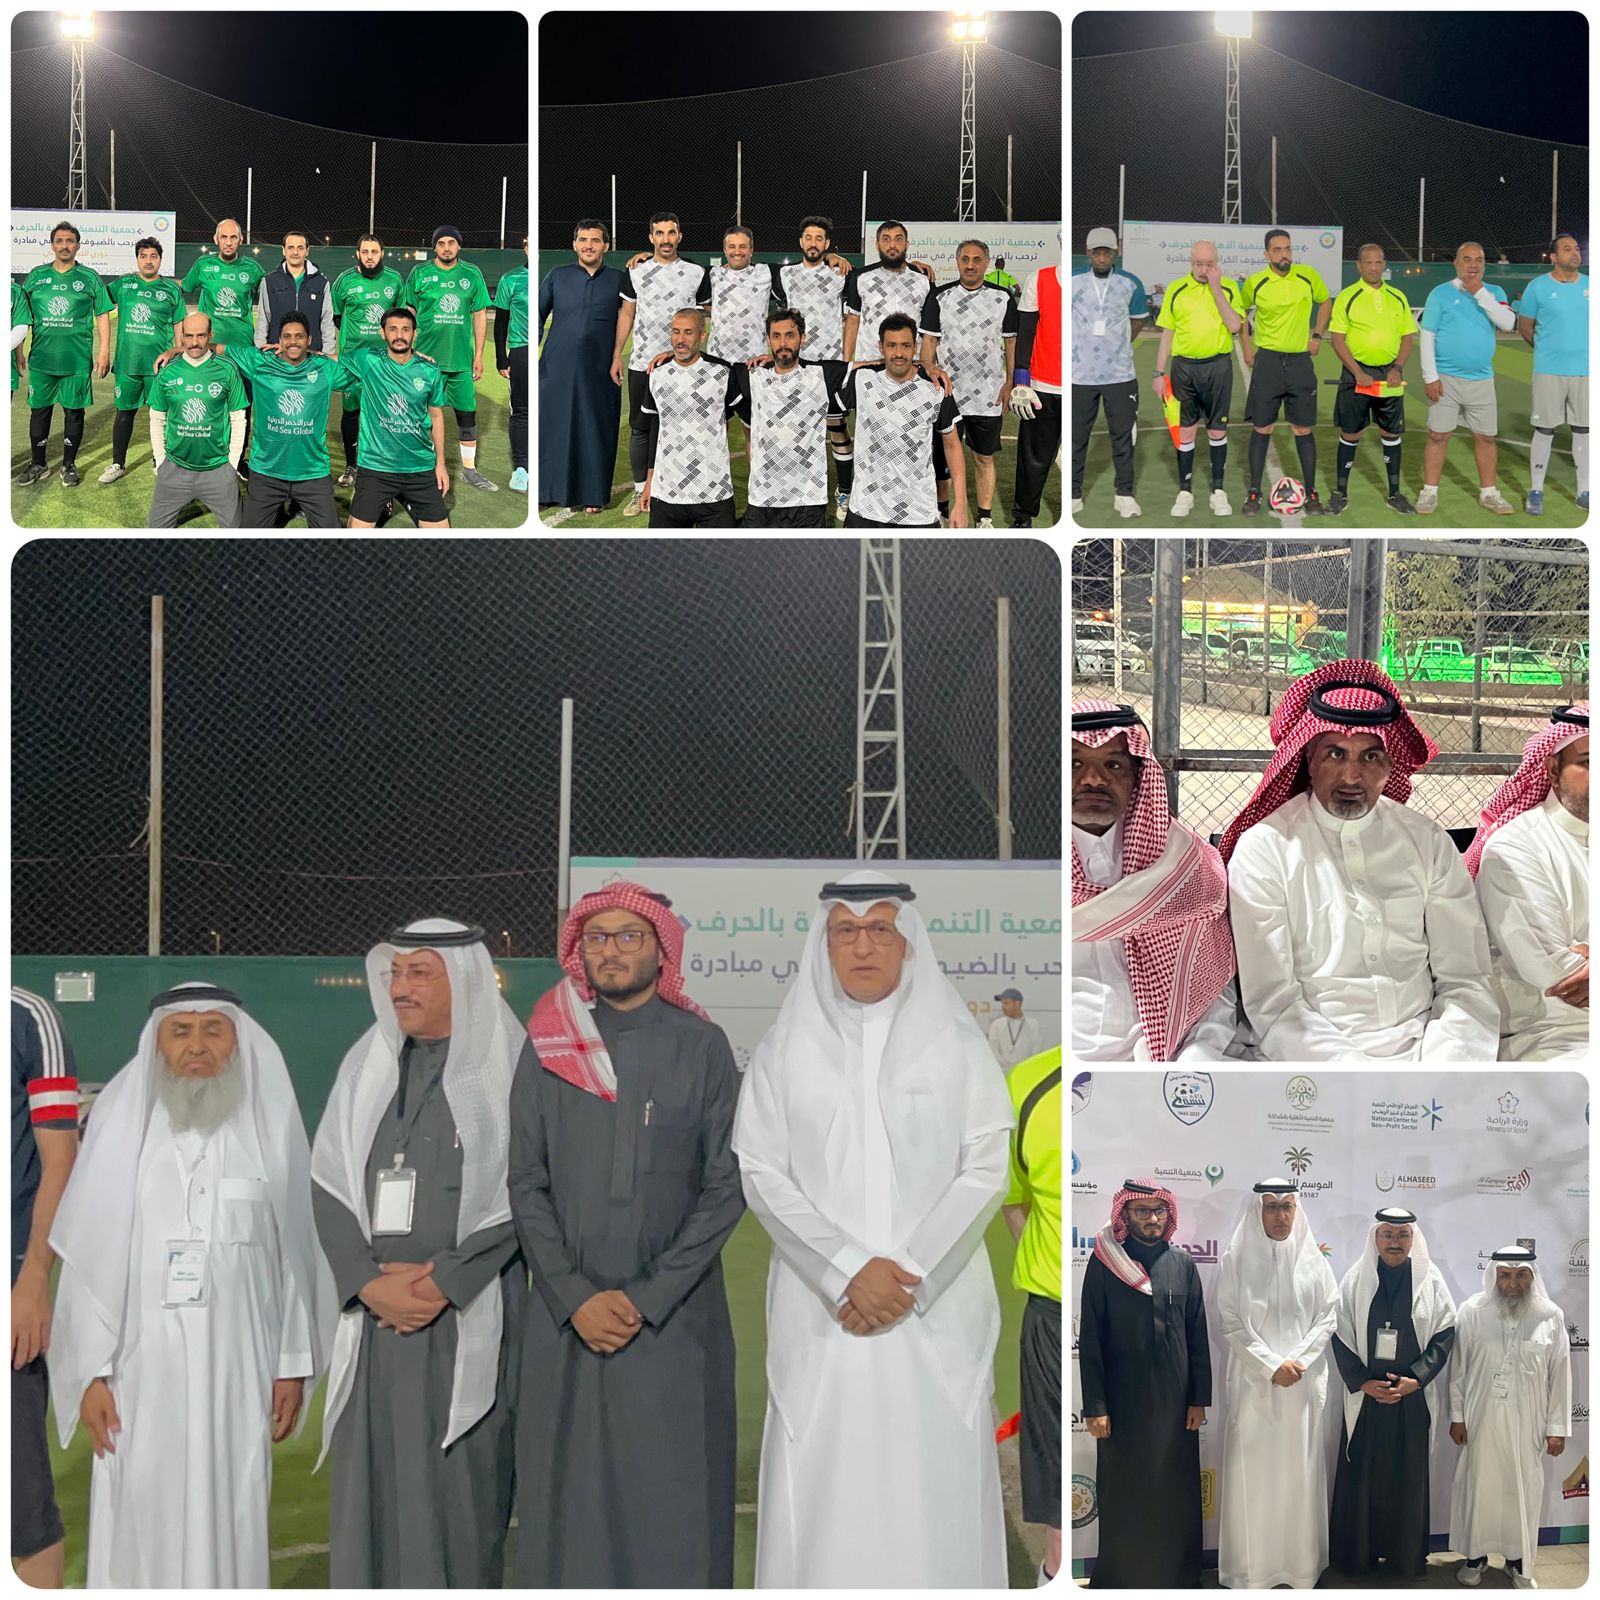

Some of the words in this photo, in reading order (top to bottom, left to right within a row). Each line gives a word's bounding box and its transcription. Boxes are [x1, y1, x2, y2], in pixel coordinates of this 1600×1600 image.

[79, 224, 108, 234] التنمية
[110, 225, 136, 235] جمعية
[13, 236, 37, 245] مبادرة
[1007, 238, 1036, 248] جمعية
[1015, 252, 1038, 262] ترحب
[267, 422, 279, 433] Red
[280, 425, 291, 434] Sea
[293, 426, 314, 435] Global
[696, 907, 784, 938] بالحرف
[926, 908, 991, 934] التنم
[1001, 912, 1061, 940] معية
[690, 950, 763, 978] مبادرة
[1511, 1116, 1528, 1127] وزارة
[1154, 1167, 1178, 1176] التنمية
[1177, 1168, 1202, 1178] جمعية
[1397, 1175, 1436, 1183] ALHASEED
[1072, 1181, 1098, 1189] مؤسس
[1300, 1180, 1333, 1191] الموسم
